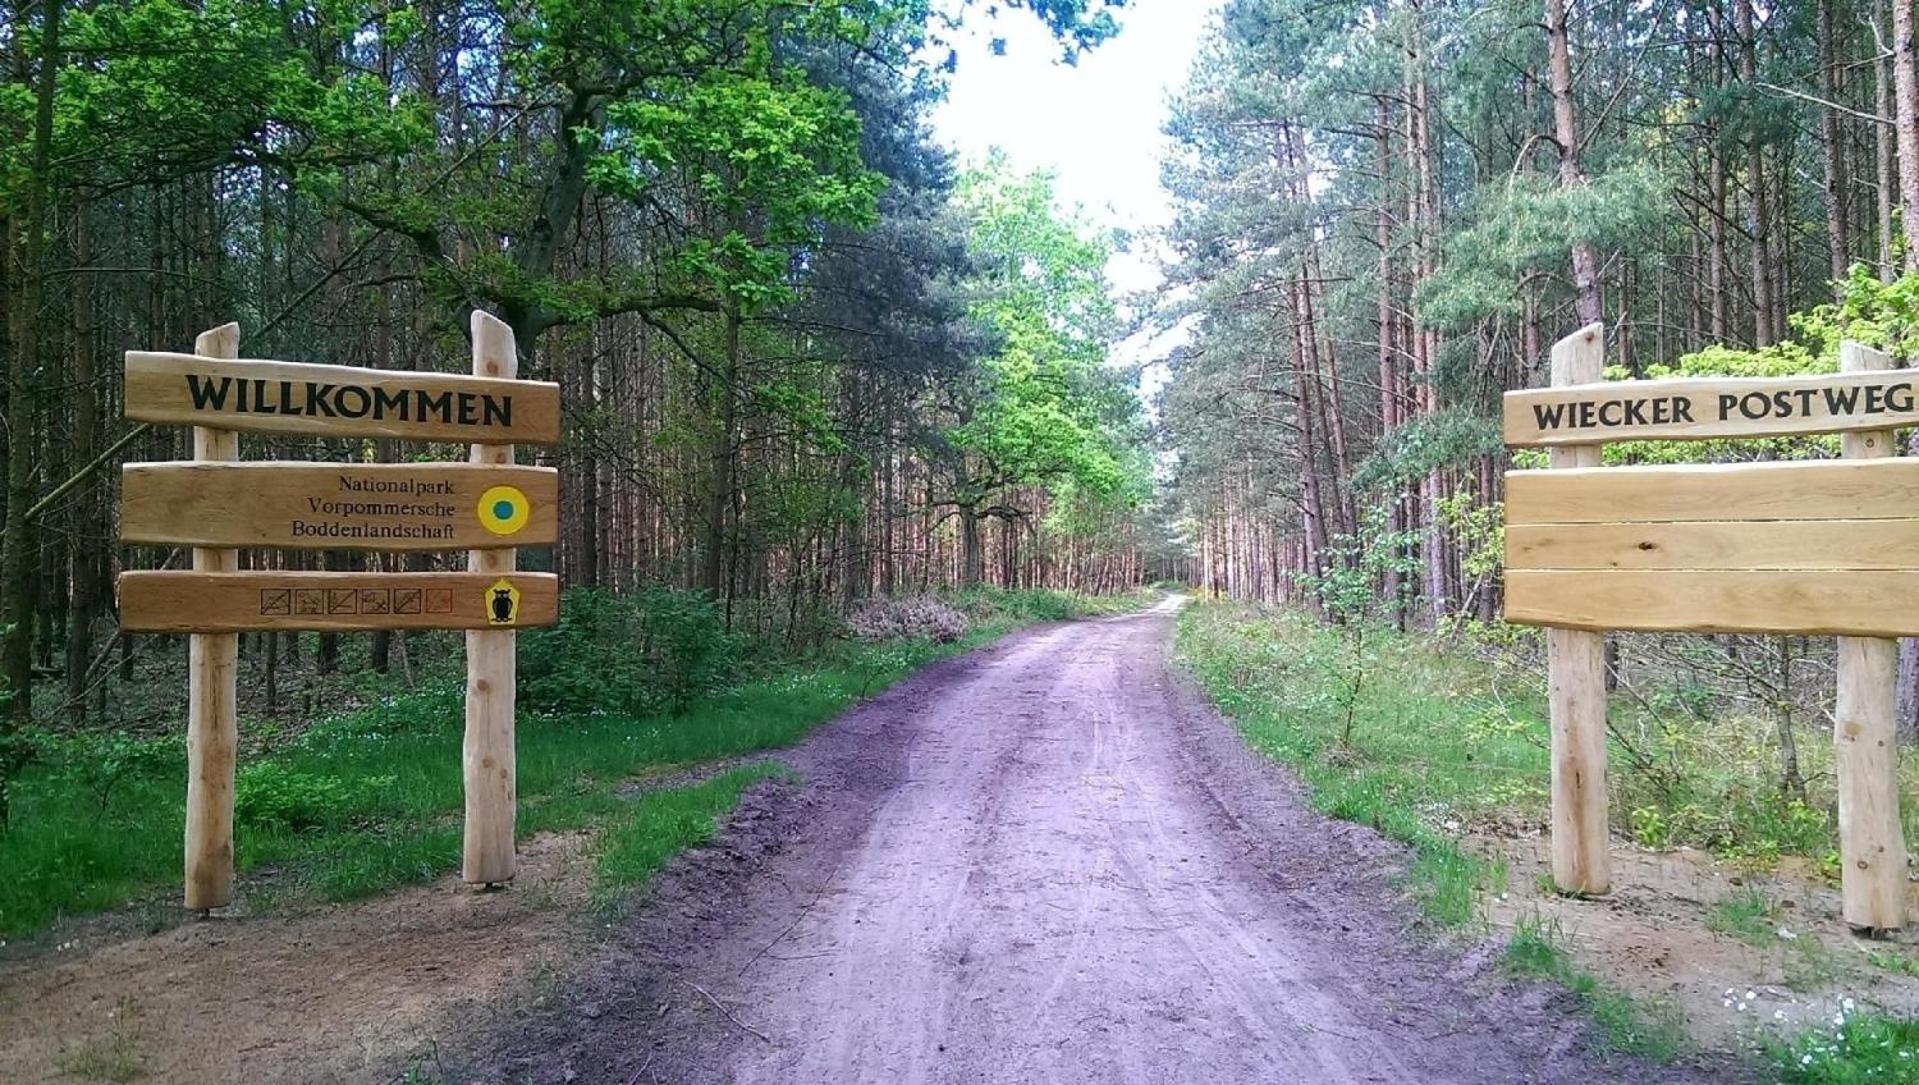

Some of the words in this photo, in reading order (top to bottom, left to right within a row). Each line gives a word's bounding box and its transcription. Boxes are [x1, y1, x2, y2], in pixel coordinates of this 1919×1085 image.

[185, 374, 512, 427] WILLKOMMEN
[1533, 396, 1696, 431] WIECKER
[1718, 383, 1914, 421] POSTWEG
[338, 475, 456, 496] Nationalpark
[307, 496, 456, 518] Vorpommersche
[292, 519, 455, 539] Boddenlandschaft
